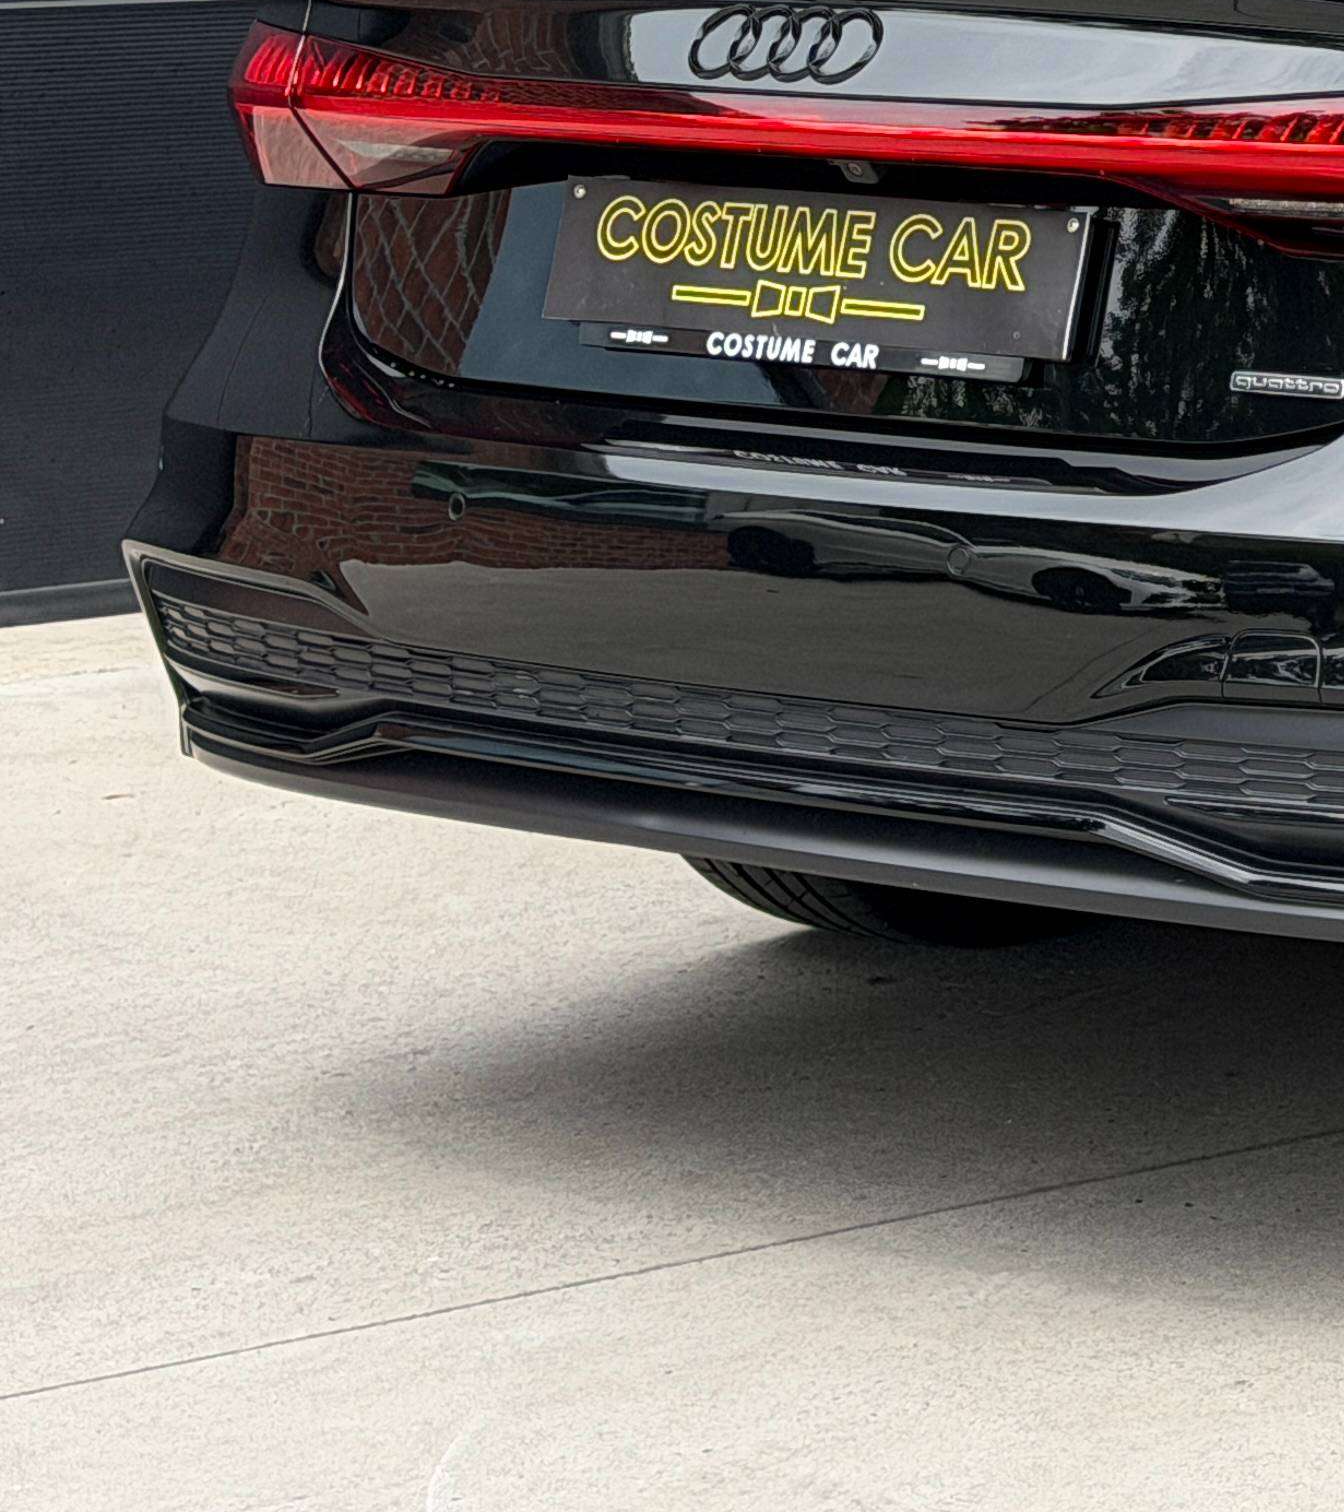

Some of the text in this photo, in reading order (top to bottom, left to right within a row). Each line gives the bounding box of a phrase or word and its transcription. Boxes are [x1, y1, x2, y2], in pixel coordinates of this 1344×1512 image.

[597, 195, 1031, 291] COSTUME CAR
[706, 331, 880, 369] COSTUME CAR
[1235, 374, 1340, 394] quattro
